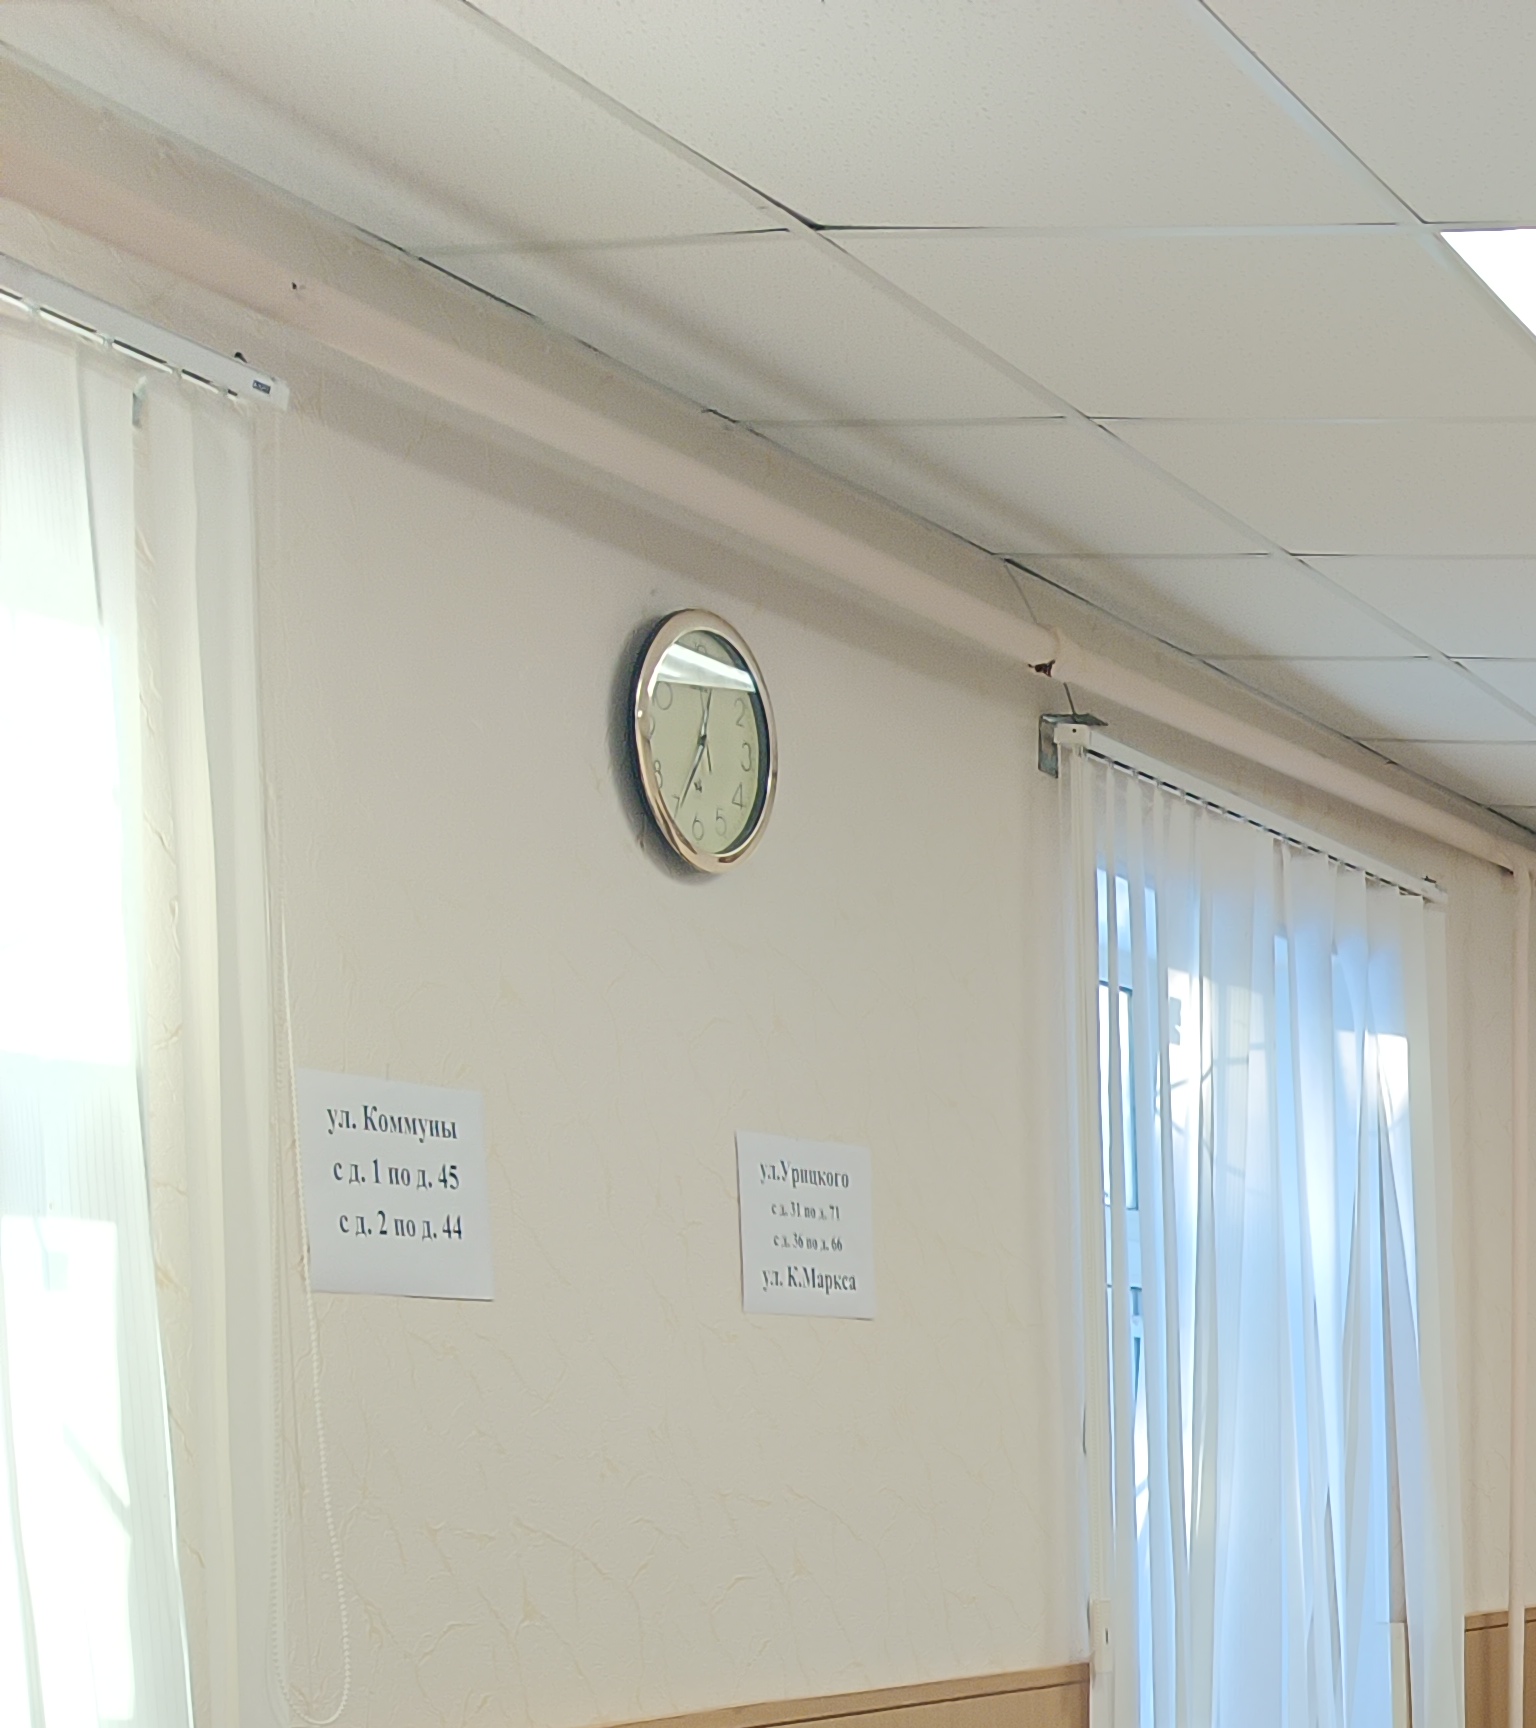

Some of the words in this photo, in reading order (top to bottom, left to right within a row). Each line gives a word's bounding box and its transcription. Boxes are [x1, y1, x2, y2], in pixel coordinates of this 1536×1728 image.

[734, 697, 748, 728] 2
[741, 741, 752, 773] 3
[731, 781, 745, 811] 4
[691, 813, 705, 842] 6
[715, 807, 728, 837] 5
[326, 1108, 357, 1135] ул.
[362, 1104, 458, 1144] Коммуны
[333, 1161, 344, 1182] с
[348, 1163, 366, 1186] д.
[372, 1157, 382, 1185] 1
[387, 1166, 411, 1187] по
[416, 1168, 433, 1192] д.
[437, 1163, 460, 1190] 45
[339, 1214, 350, 1234] с
[355, 1215, 373, 1238] д.
[376, 1209, 388, 1236] 2
[393, 1217, 417, 1238] по
[421, 1219, 438, 1242] д.
[441, 1213, 463, 1241] 44
[790, 1200, 801, 1218] 31
[804, 1205, 817, 1220] по
[828, 1204, 841, 1222] 71
[806, 1236, 818, 1251] по
[831, 1236, 843, 1252] 66
[761, 1269, 784, 1293] ул.
